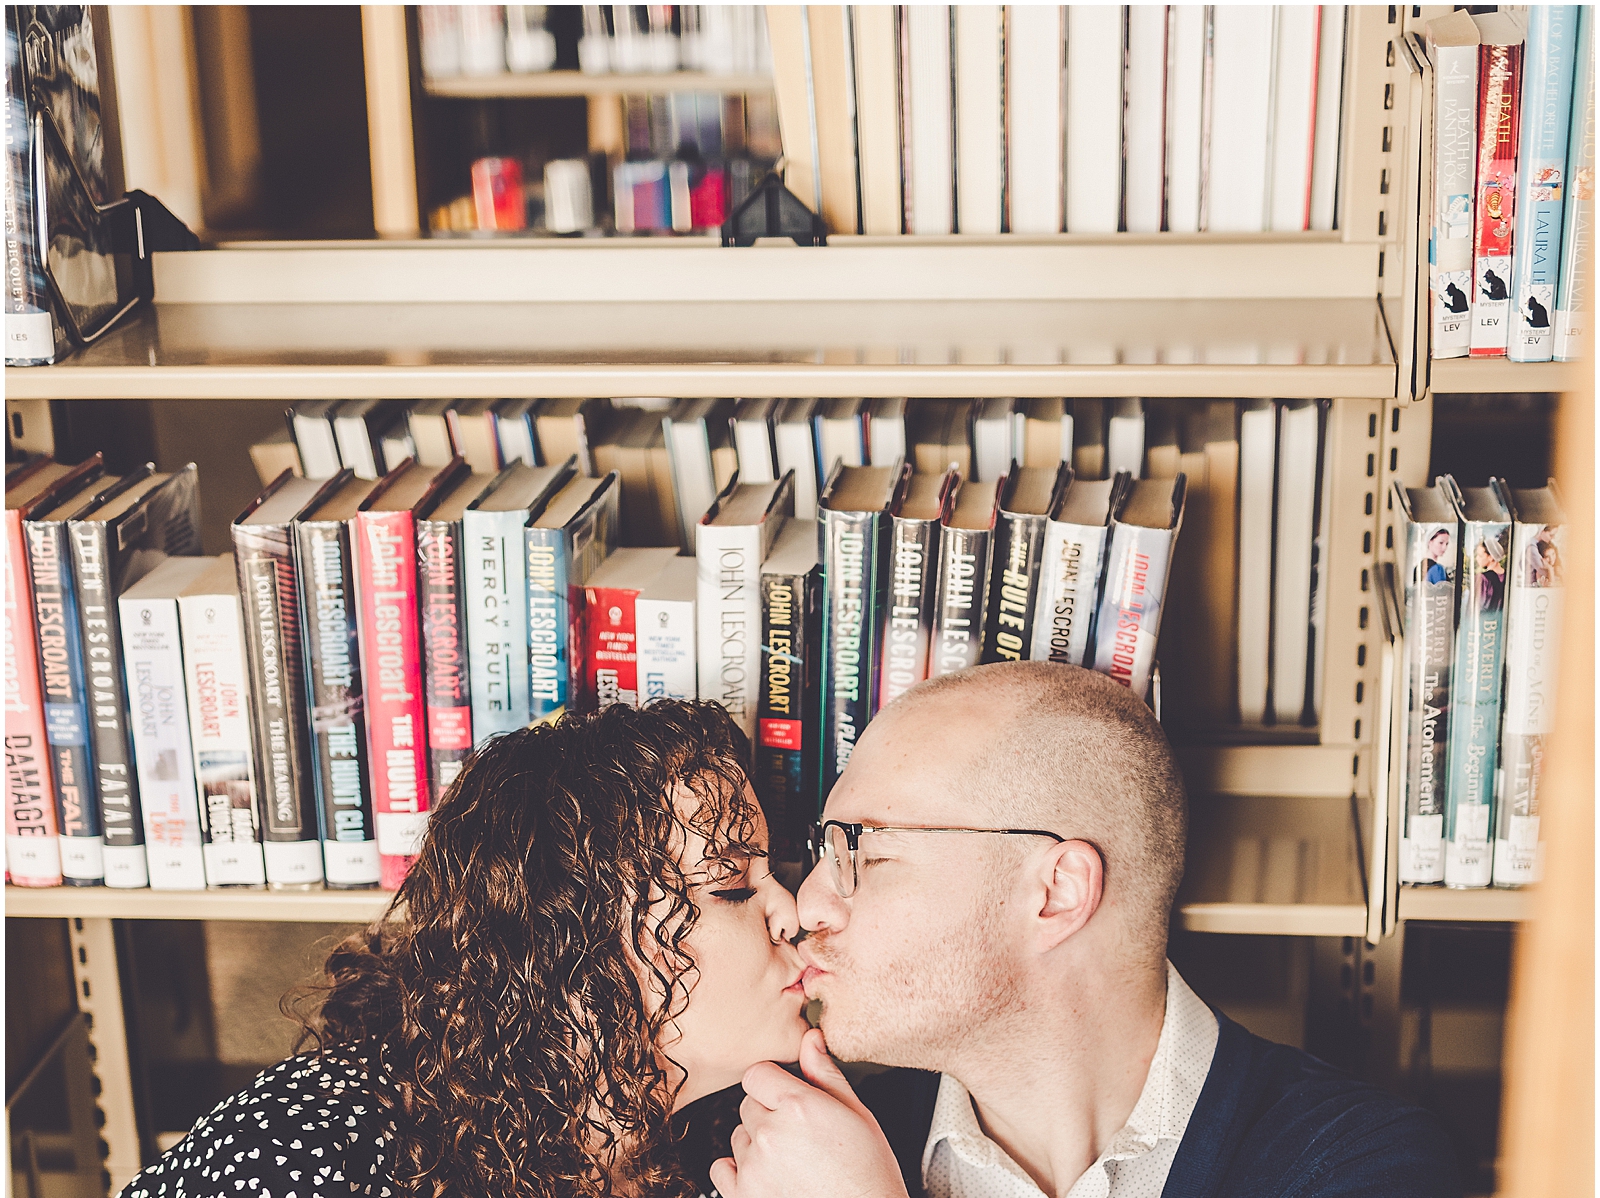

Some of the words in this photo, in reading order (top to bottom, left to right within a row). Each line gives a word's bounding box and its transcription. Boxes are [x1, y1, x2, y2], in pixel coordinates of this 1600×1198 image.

[1550, 44, 1560, 54] A
[1499, 94, 1513, 143] DEATH
[1542, 56, 1560, 151] BACHELORETTE
[1442, 99, 1458, 191] PANTYHOSE
[1457, 108, 1470, 160] DEATH
[1456, 163, 1467, 180] BY
[1533, 210, 1551, 266] LAURA
[1574, 210, 1591, 265] LAURA
[7, 240, 25, 312] BECQUETS
[11, 333, 28, 342] LES
[1442, 314, 1467, 322] MYSTERY
[1443, 323, 1461, 333] LEV
[1480, 318, 1500, 327] LEV
[1564, 327, 1583, 337] LEV
[79, 531, 102, 591] JOHN
[311, 536, 343, 584] JOHN
[372, 534, 404, 586] John
[426, 535, 455, 586] JOHN
[481, 535, 499, 627] MERCY
[528, 540, 556, 592] JOHN
[717, 547, 745, 602] JOHN
[840, 531, 864, 583] JOHN
[893, 543, 923, 598] JOHN
[946, 554, 976, 609] JOHN
[252, 573, 273, 618] JOHN
[769, 582, 793, 626] JOHN
[999, 568, 1029, 632] RULE
[1533, 593, 1549, 651] CHILD
[36, 592, 72, 698] LESCROART
[316, 588, 353, 688] LESCROART
[373, 591, 415, 703] Lescroart
[429, 593, 461, 699] LESCROART
[502, 598, 512, 650] THE
[529, 597, 559, 703] LESCROART
[835, 588, 863, 702] LESCROART
[995, 631, 1023, 661] OF
[1433, 593, 1449, 666] BEVERLY
[85, 605, 119, 730] LESCROART
[259, 619, 283, 709] LESCROART
[486, 642, 503, 712] RULE
[720, 611, 748, 719] LESCROART
[768, 629, 792, 715] LESCROART
[888, 605, 920, 703] LESCROA
[1479, 618, 1498, 693] BEVERLY
[134, 660, 158, 738] LESCROART
[195, 661, 222, 738] LESCROART
[219, 681, 239, 719] JOHN
[1424, 671, 1439, 702] The
[269, 717, 287, 752] THE
[327, 722, 358, 758] THE
[391, 713, 414, 748] THE
[838, 711, 854, 724] A
[1470, 714, 1486, 739] The
[5, 735, 47, 837] DAMAGE
[59, 749, 75, 786] THE
[330, 759, 363, 808] HUNT
[385, 750, 419, 814] HUNT
[1419, 703, 1442, 815] Atonement
[98, 762, 134, 840] FATAL
[272, 753, 294, 822] HEARING
[1459, 857, 1480, 866] LEW
[1511, 862, 1532, 871] LEW
